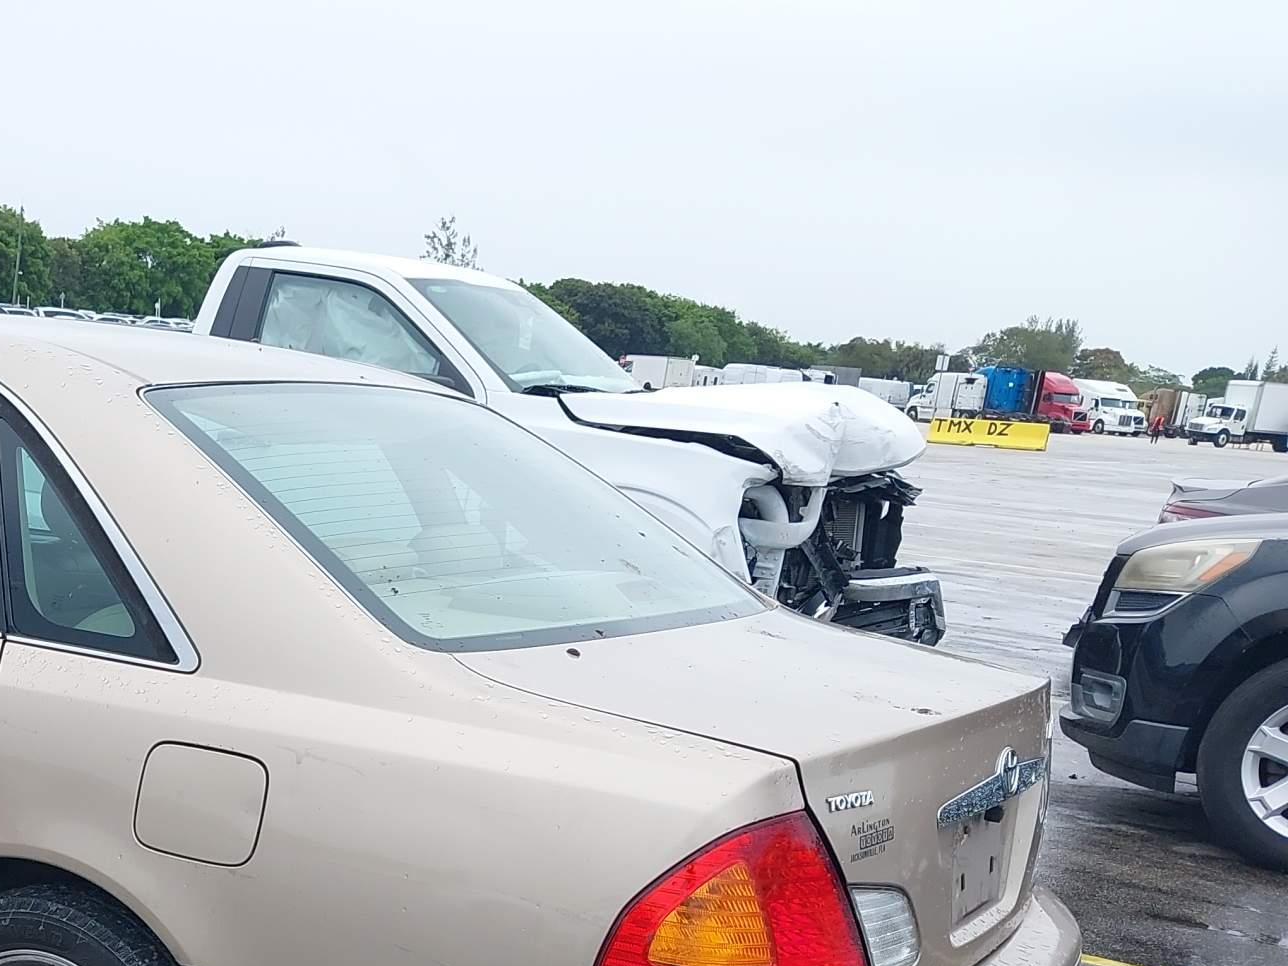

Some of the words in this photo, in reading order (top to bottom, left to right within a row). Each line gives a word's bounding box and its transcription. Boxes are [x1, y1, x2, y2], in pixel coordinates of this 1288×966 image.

[934, 418, 975, 434] TMX
[987, 421, 1014, 436] DZ
[825, 789, 875, 813] TOYOTA
